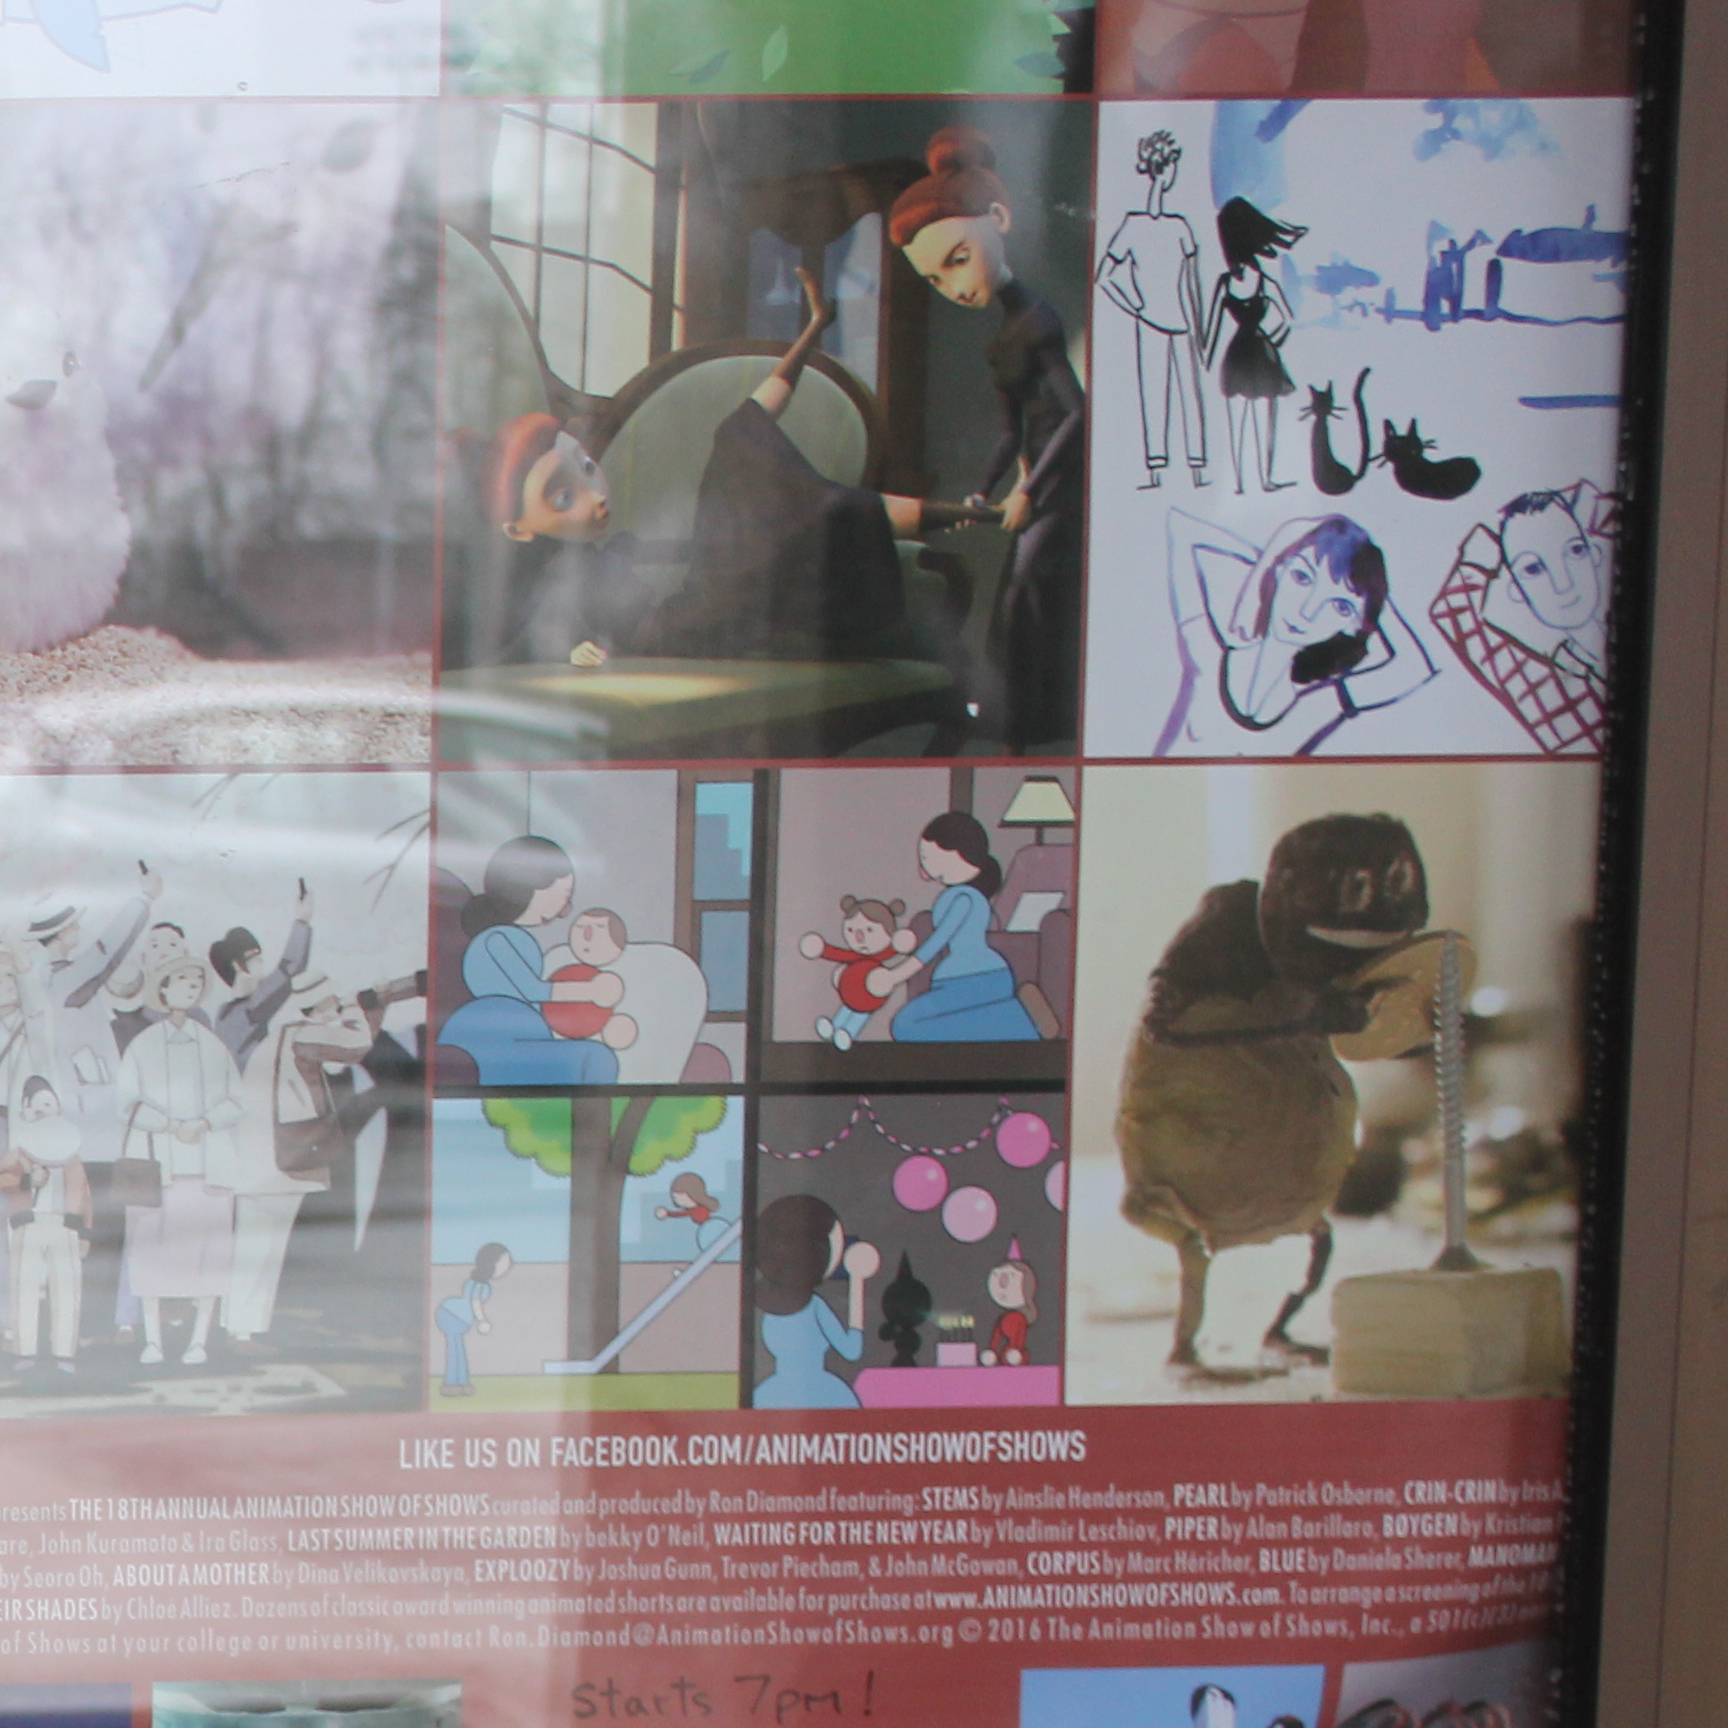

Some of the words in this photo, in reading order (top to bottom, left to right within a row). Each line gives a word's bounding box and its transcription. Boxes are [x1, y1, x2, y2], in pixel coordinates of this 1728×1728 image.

[399, 1438, 455, 1470] LIKE
[465, 1438, 498, 1468] US
[505, 1437, 540, 1468] ON
[550, 1430, 1086, 1467] FACEBOOK.COM/ANIMATIONSHOWOFSHOWS
[922, 1486, 979, 1511] STEMS
[1174, 1483, 1227, 1506] PEARL
[69, 1498, 102, 1520] THE
[105, 1497, 153, 1521] 18TH
[155, 1496, 230, 1520] ANNUAL
[233, 1496, 341, 1520] ANIMATION
[342, 1495, 394, 1518] SHOW
[399, 1494, 424, 1517] OF
[425, 1493, 489, 1516] SHOWS
[288, 1528, 330, 1552] LAST
[334, 1528, 414, 1550] SUMMER
[420, 1528, 438, 1550] IN
[444, 1526, 476, 1549] THE
[480, 1526, 556, 1549] GARDEN
[1164, 1516, 1218, 1540] PIPER
[474, 1558, 570, 1582] EXPLOOZY
[1027, 1552, 1100, 1574] CORPUS
[1259, 1548, 1306, 1572] BLUE
[114, 1564, 175, 1586] ABOUT
[178, 1564, 194, 1586] A
[196, 1563, 268, 1585] MOTHER
[26, 1599, 98, 1620] SHADES
